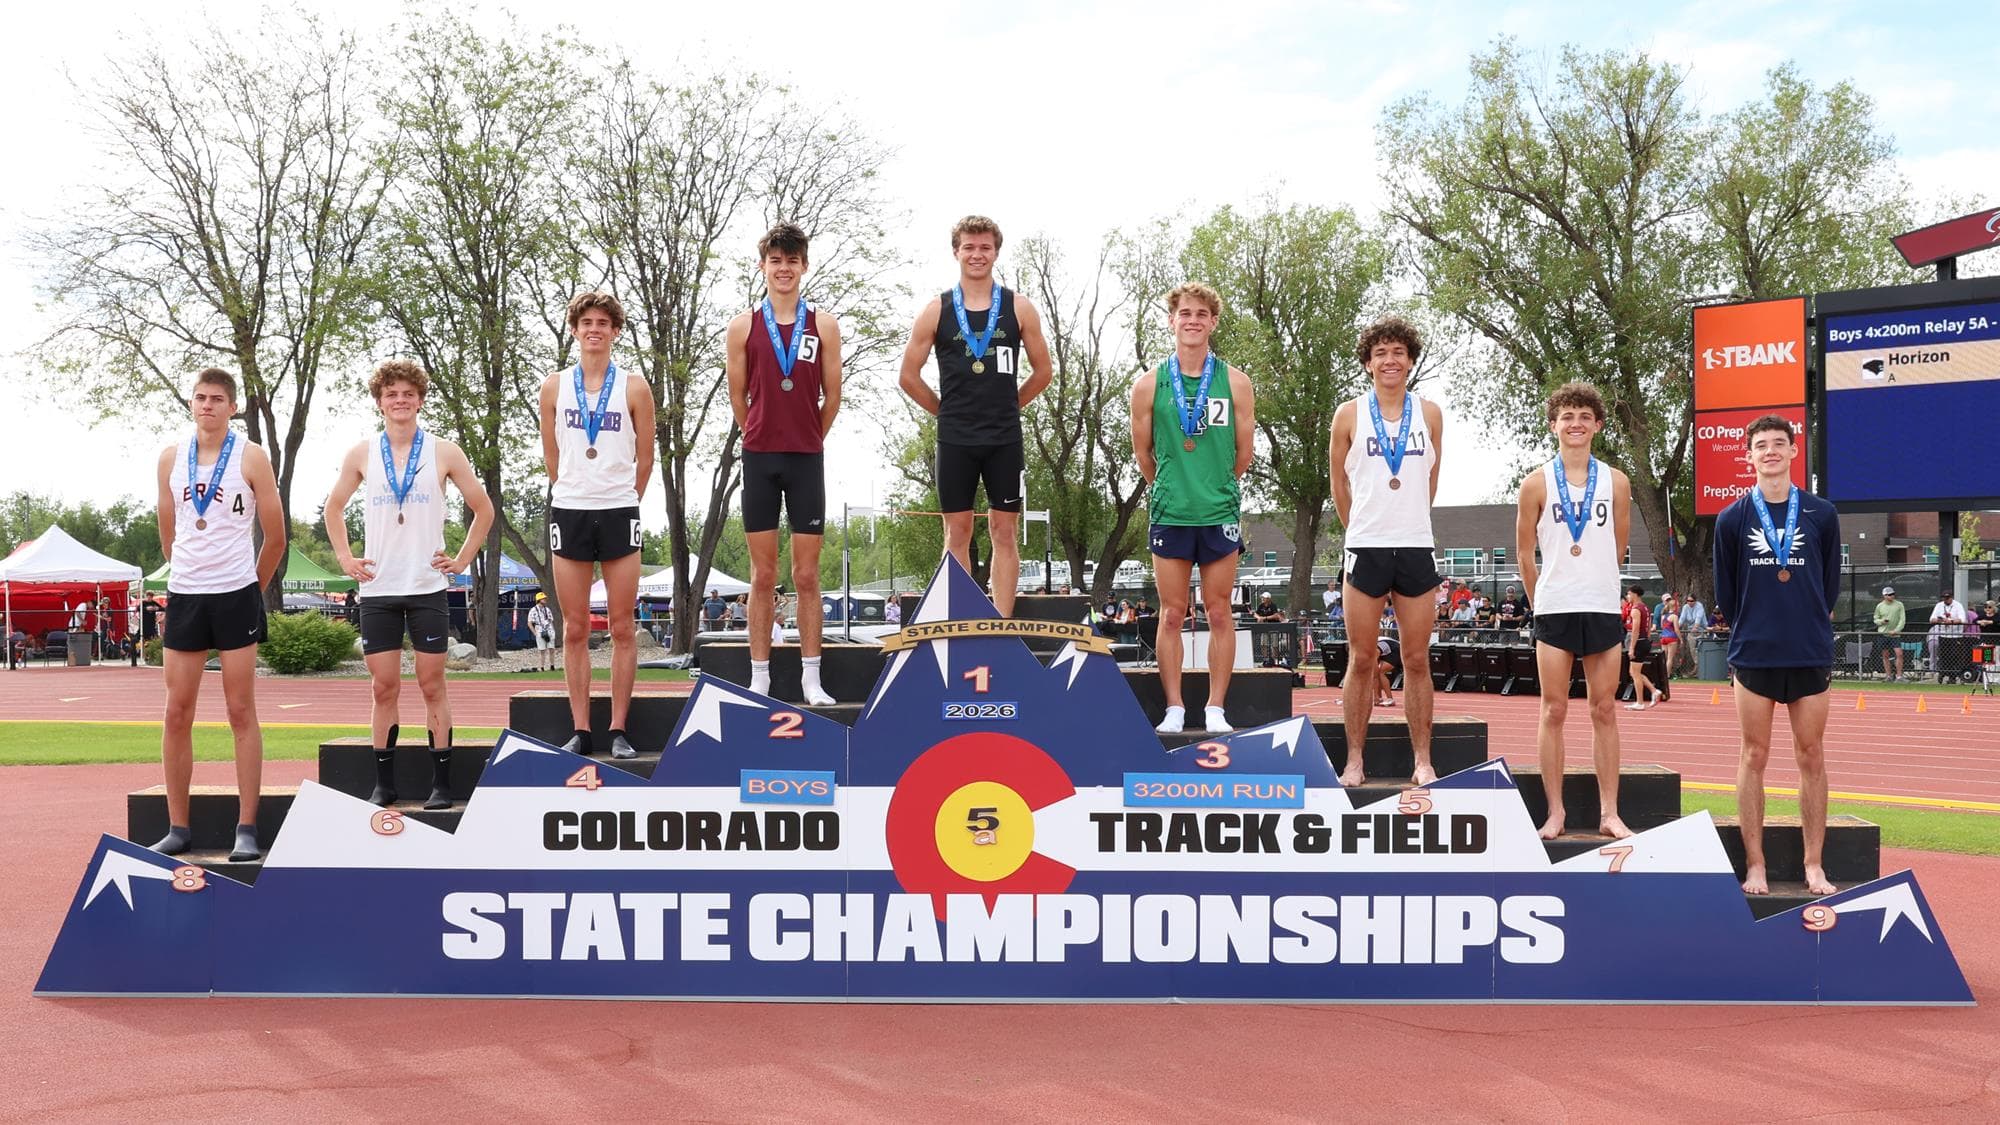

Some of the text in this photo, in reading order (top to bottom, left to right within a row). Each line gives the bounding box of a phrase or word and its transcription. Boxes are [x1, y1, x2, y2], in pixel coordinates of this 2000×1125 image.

[1829, 329, 1863, 344] Boys
[1865, 325, 1921, 338] 4x200m
[1924, 319, 1965, 334] Relay
[1968, 317, 1989, 330] 5A
[802, 337, 815, 360] 5
[1888, 351, 1950, 366] Horizon
[1002, 349, 1010, 372] 1
[1888, 373, 1896, 383] A
[1212, 400, 1224, 424] 2
[1408, 431, 1425, 449] 11
[1697, 425, 1744, 440] CO Prep
[1711, 443, 1723, 452] We
[183, 483, 224, 503] ERE
[232, 493, 245, 516] 4
[1596, 502, 1608, 527] 9
[551, 525, 558, 548] 6
[634, 522, 640, 545] 6
[1749, 558, 1775, 566] TRACK
[300, 580, 324, 589] FIELD
[907, 621, 1085, 637] STATE CHAMPION
[963, 665, 990, 693] 1
[945, 704, 1016, 718] 2026
[768, 710, 804, 739] 2
[1194, 741, 1231, 770] 3
[565, 764, 604, 791] 4
[747, 778, 828, 796] BOYS
[1133, 782, 1295, 800] 3200M RUN
[1397, 788, 1433, 815] 5
[370, 809, 405, 836] 6
[543, 811, 840, 851] COLORADO
[966, 807, 1000, 832] 5
[1089, 812, 1488, 854] TRACK & FIELD
[1599, 845, 1634, 873] 7
[171, 865, 207, 893] 8
[441, 891, 1566, 963] STATE CHAMPIONSHIPS
[1801, 904, 1838, 933] 9
